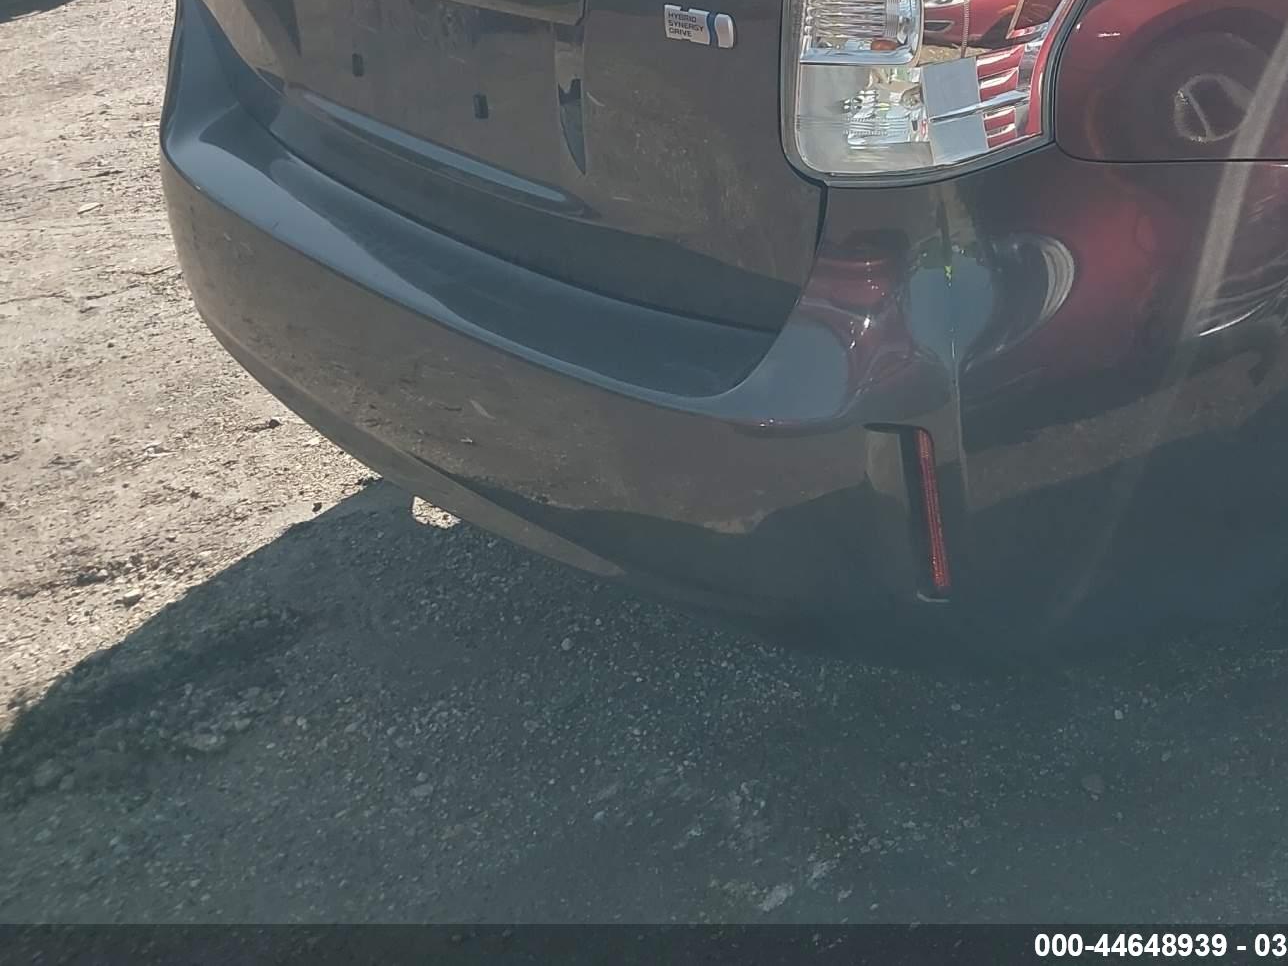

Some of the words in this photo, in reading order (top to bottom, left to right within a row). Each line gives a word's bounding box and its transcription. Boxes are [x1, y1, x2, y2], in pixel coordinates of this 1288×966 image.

[668, 12, 697, 23] HYBRID
[668, 20, 704, 33] SYNERGY
[668, 27, 693, 37] DRIVE
